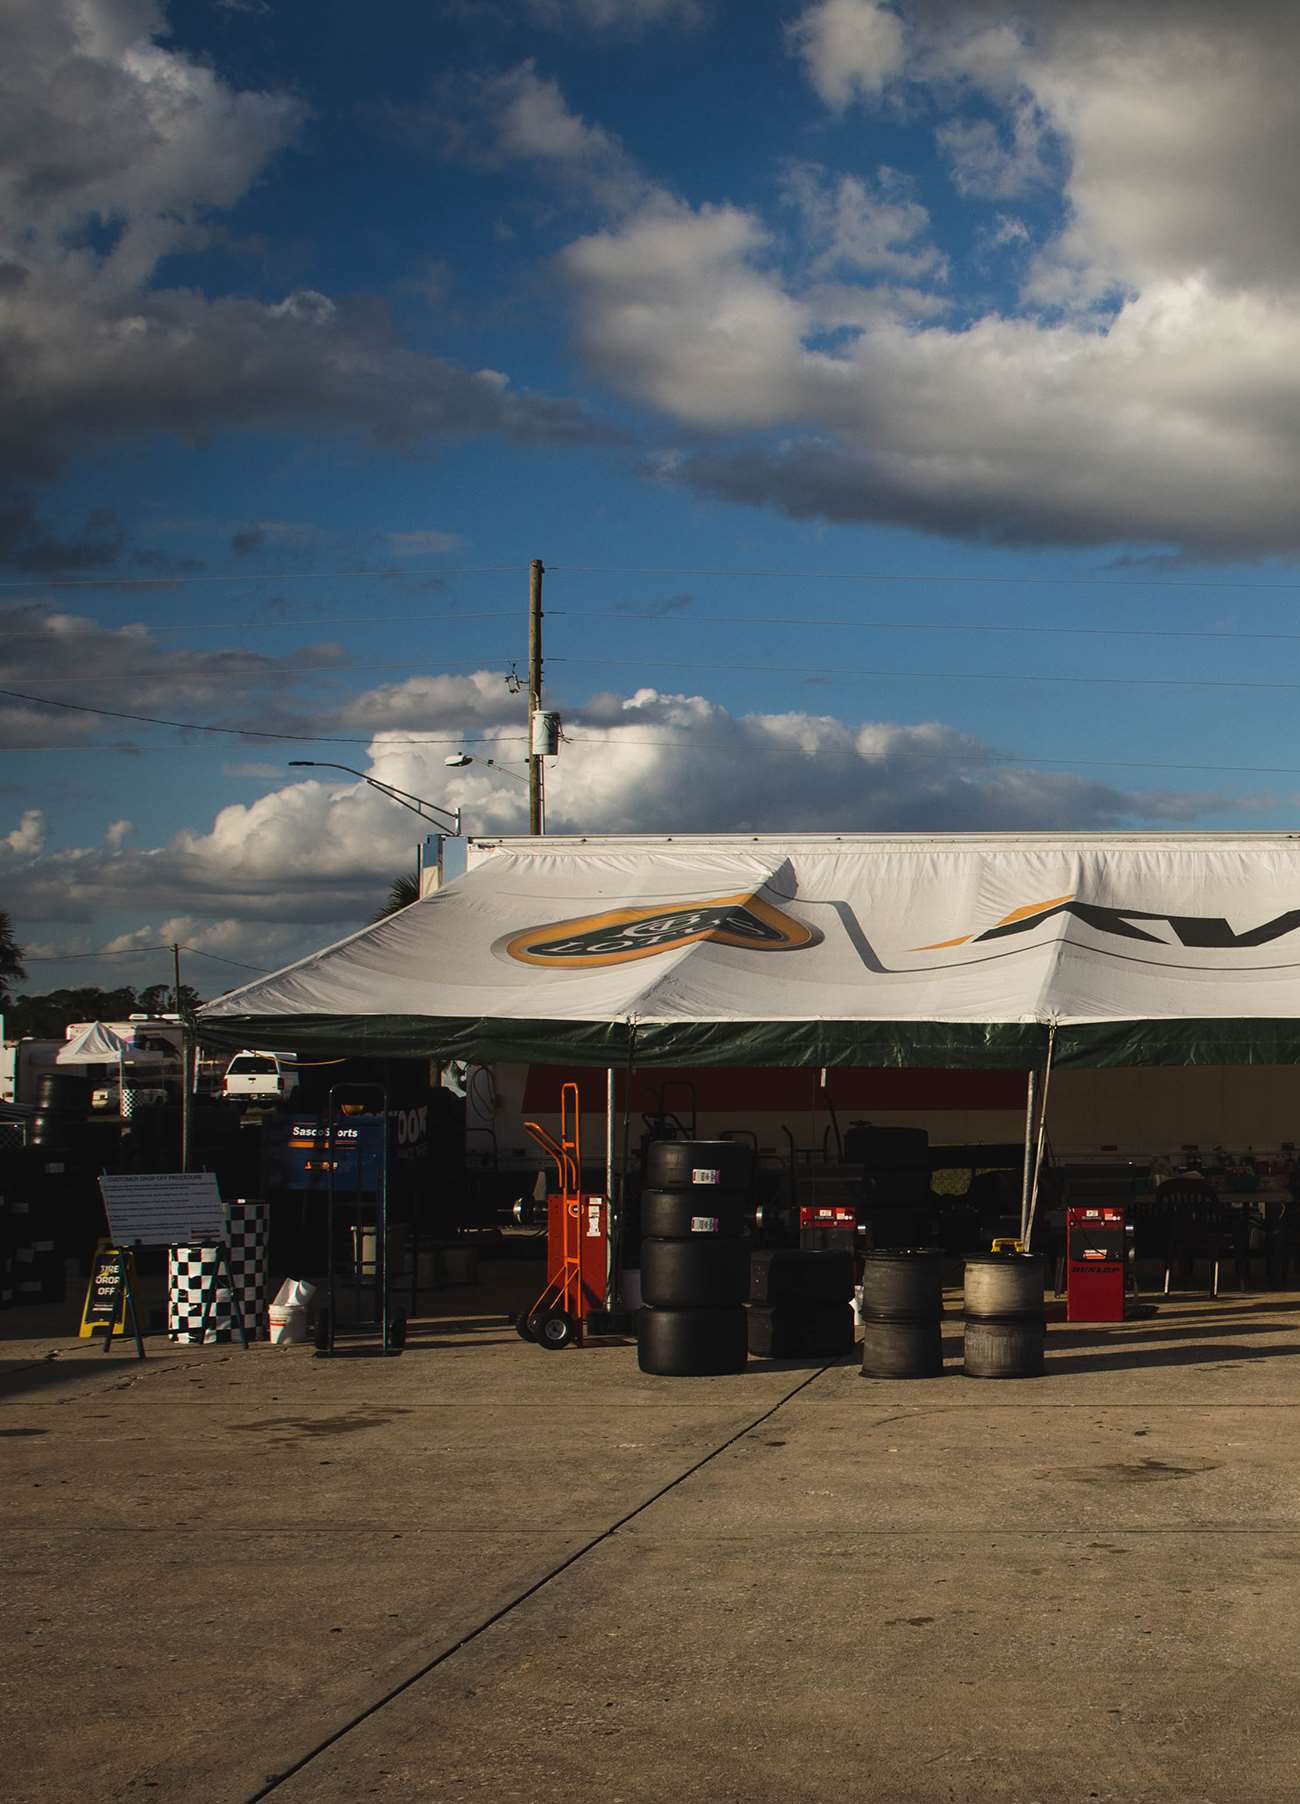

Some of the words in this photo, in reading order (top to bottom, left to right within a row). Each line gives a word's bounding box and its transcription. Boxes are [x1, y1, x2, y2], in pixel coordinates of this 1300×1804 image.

[542, 916, 767, 953] LOTUS
[291, 1125, 359, 1139] SascoSorts
[97, 1287, 115, 1296] OFF
